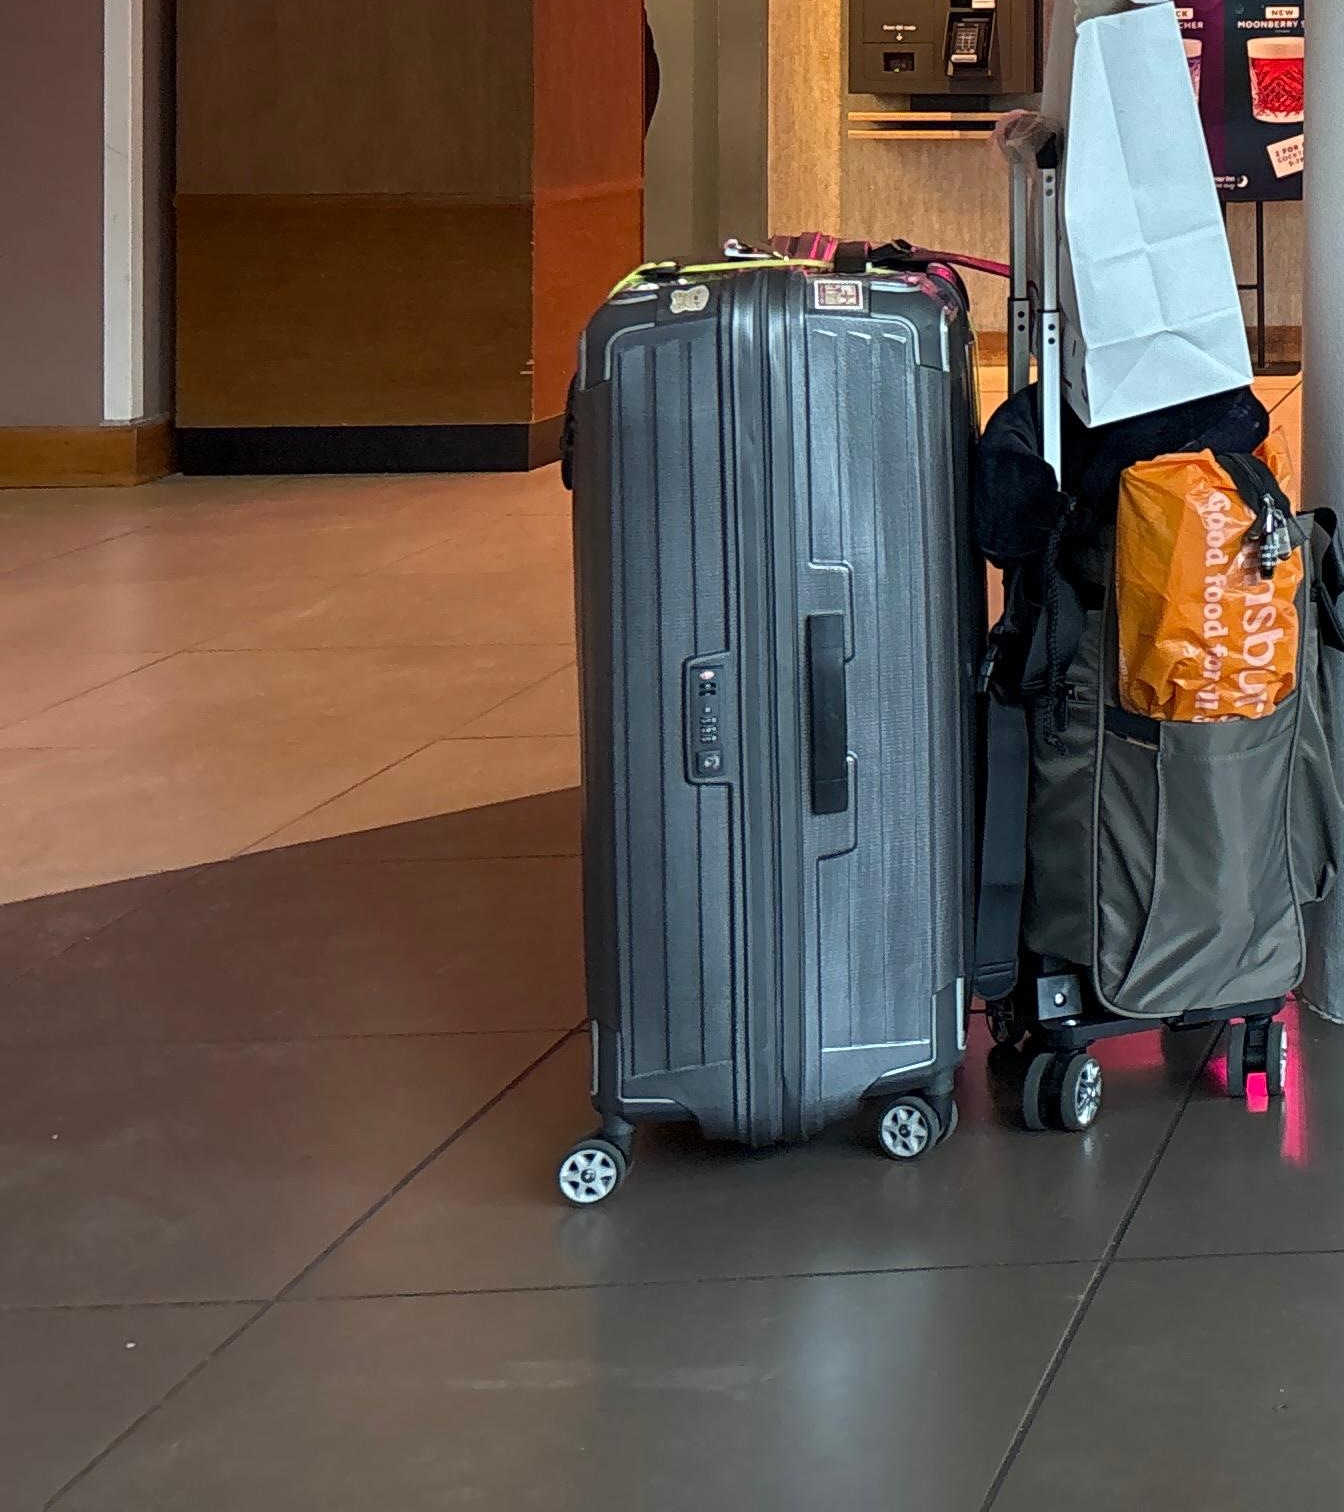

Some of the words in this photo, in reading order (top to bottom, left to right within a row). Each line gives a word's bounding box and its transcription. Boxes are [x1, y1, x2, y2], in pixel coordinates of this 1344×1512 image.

[1237, 20, 1299, 29] MOONBERRY
[1271, 9, 1294, 17] NEW
[1203, 491, 1233, 568] Good
[1202, 573, 1229, 639] food
